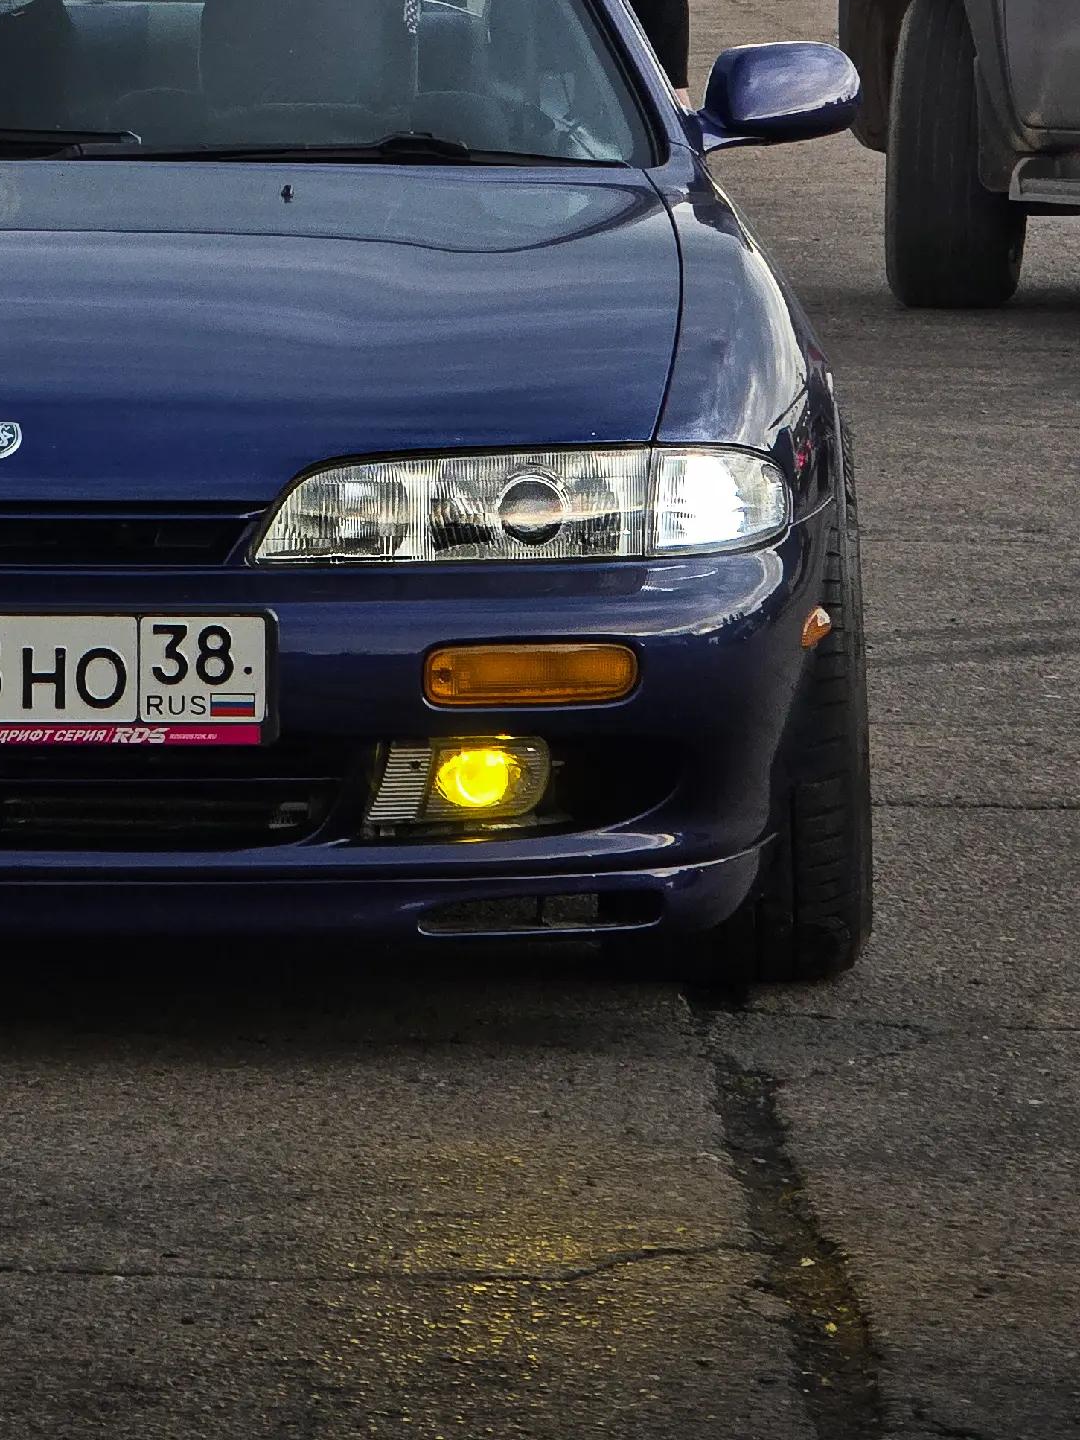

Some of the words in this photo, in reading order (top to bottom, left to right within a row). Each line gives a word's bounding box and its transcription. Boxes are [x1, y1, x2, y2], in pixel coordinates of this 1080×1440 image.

[152, 624, 234, 686] 38
[146, 695, 207, 715] RUS
[54, 730, 107, 742] СЕРИЯ
[112, 727, 170, 744] RDS
